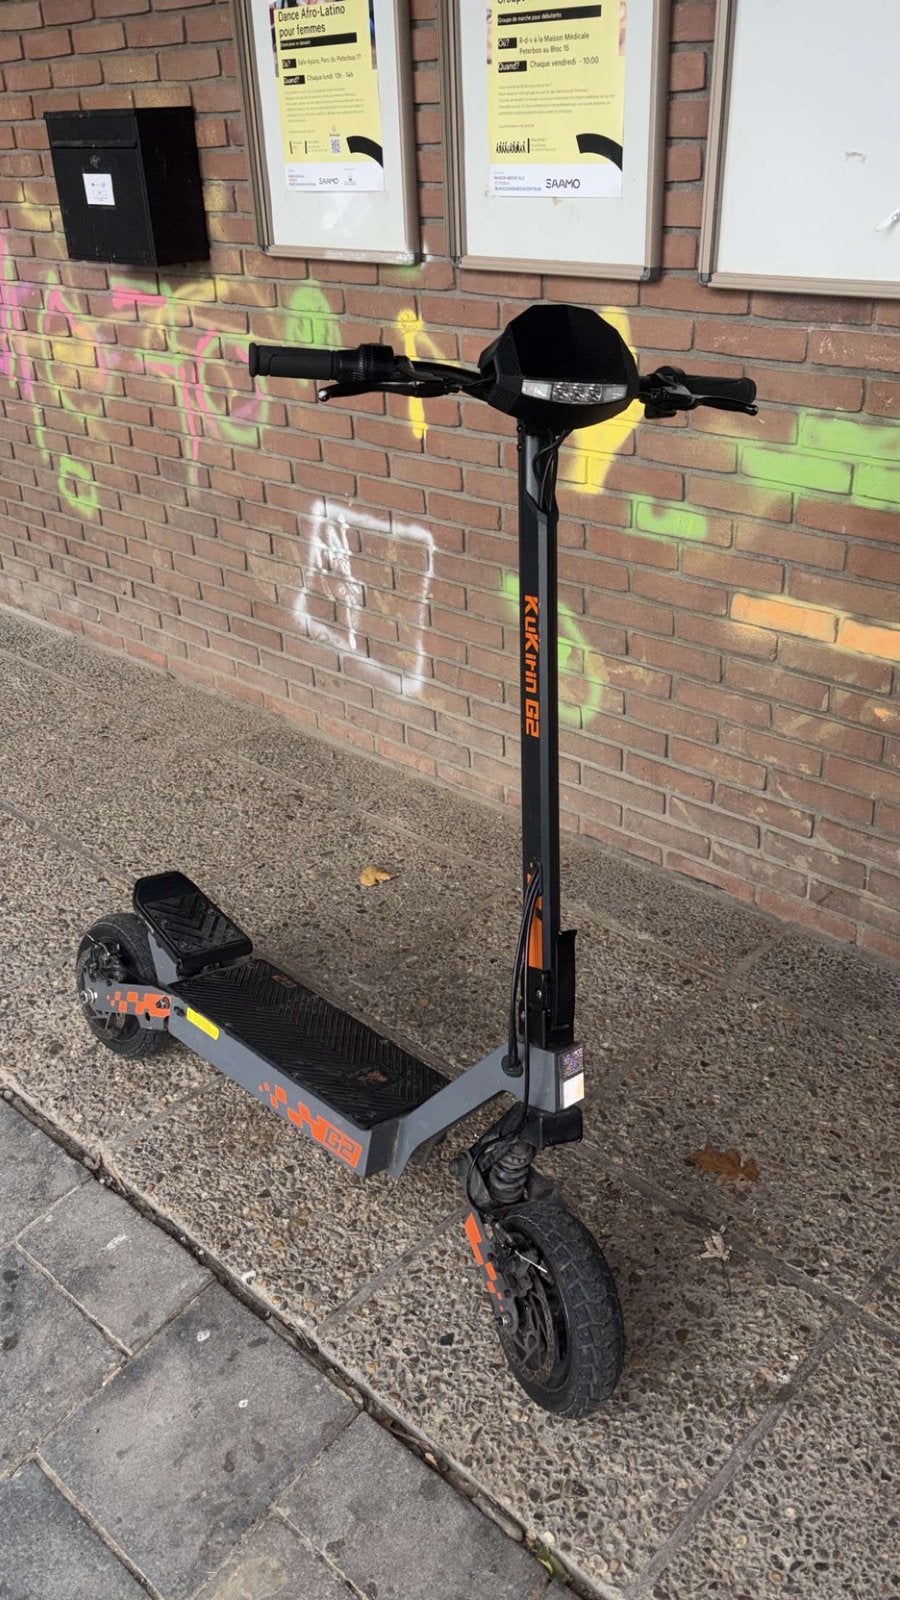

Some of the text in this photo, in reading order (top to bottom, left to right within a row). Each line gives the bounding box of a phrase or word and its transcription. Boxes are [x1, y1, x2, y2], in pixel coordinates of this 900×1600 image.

[278, 5, 346, 22] Dance Afro-Latino
[542, 12, 562, 20] débutants
[279, 24, 326, 38] pour femmes
[538, 35, 543, 43] la
[544, 34, 563, 42] Maison
[564, 32, 590, 40] Médicale
[519, 46, 542, 54] Peterbos
[550, 45, 562, 53] Bloc
[564, 44, 570, 52] 15
[498, 61, 520, 71] Quand?
[530, 60, 550, 68] Chaque
[551, 58, 576, 66] vendredi
[583, 56, 600, 64] 10:00
[545, 178, 581, 189] SAAMO
[525, 699, 540, 738] G2
[325, 1128, 355, 1160] G2
